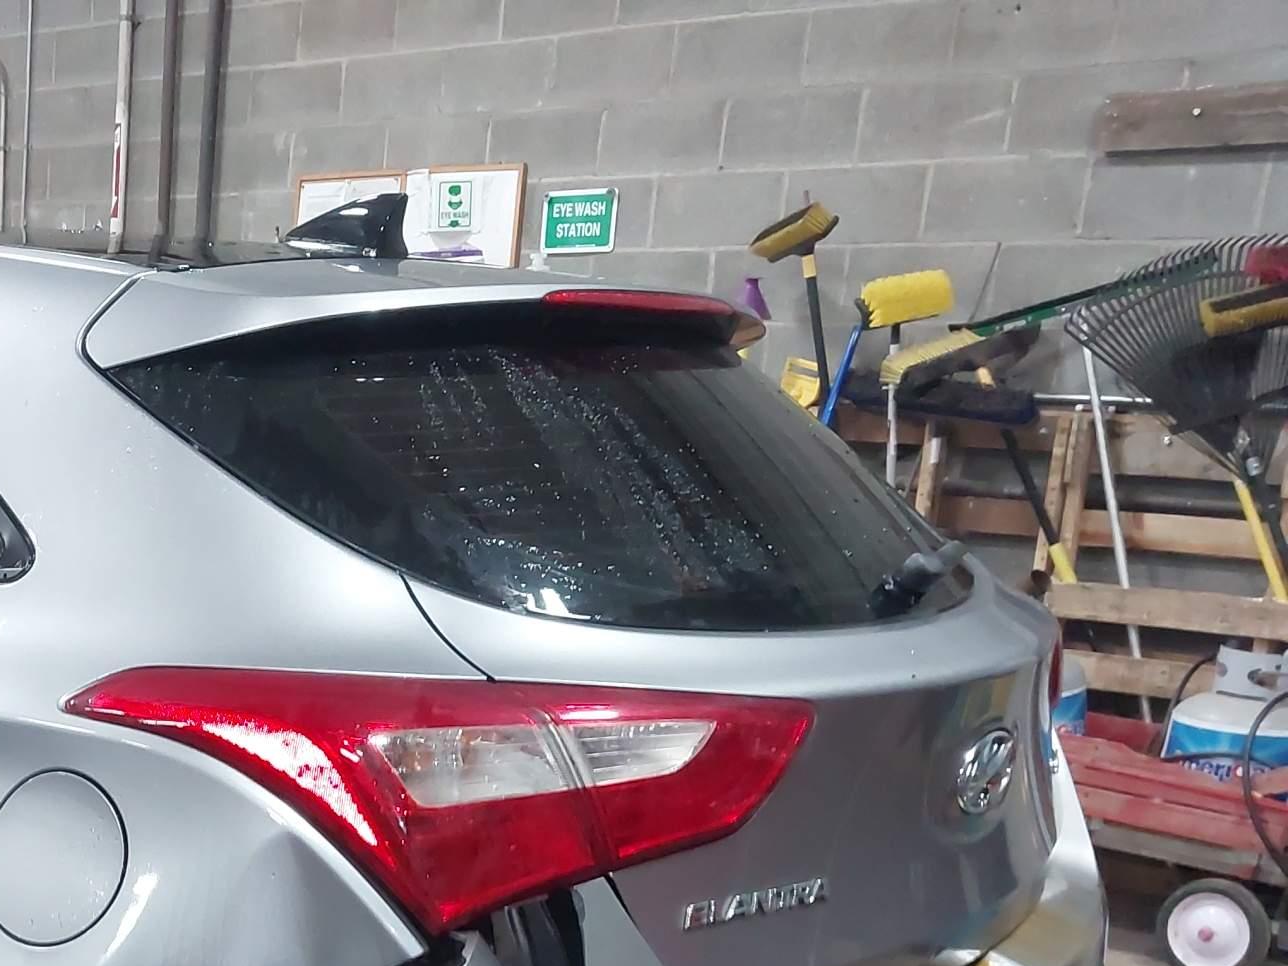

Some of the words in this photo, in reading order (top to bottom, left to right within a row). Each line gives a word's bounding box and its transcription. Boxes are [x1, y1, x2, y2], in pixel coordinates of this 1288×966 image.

[440, 211, 452, 220] EYE
[452, 210, 469, 219] WASH
[552, 203, 573, 218] EYE
[574, 201, 606, 217] WASH
[556, 222, 601, 238] STATION
